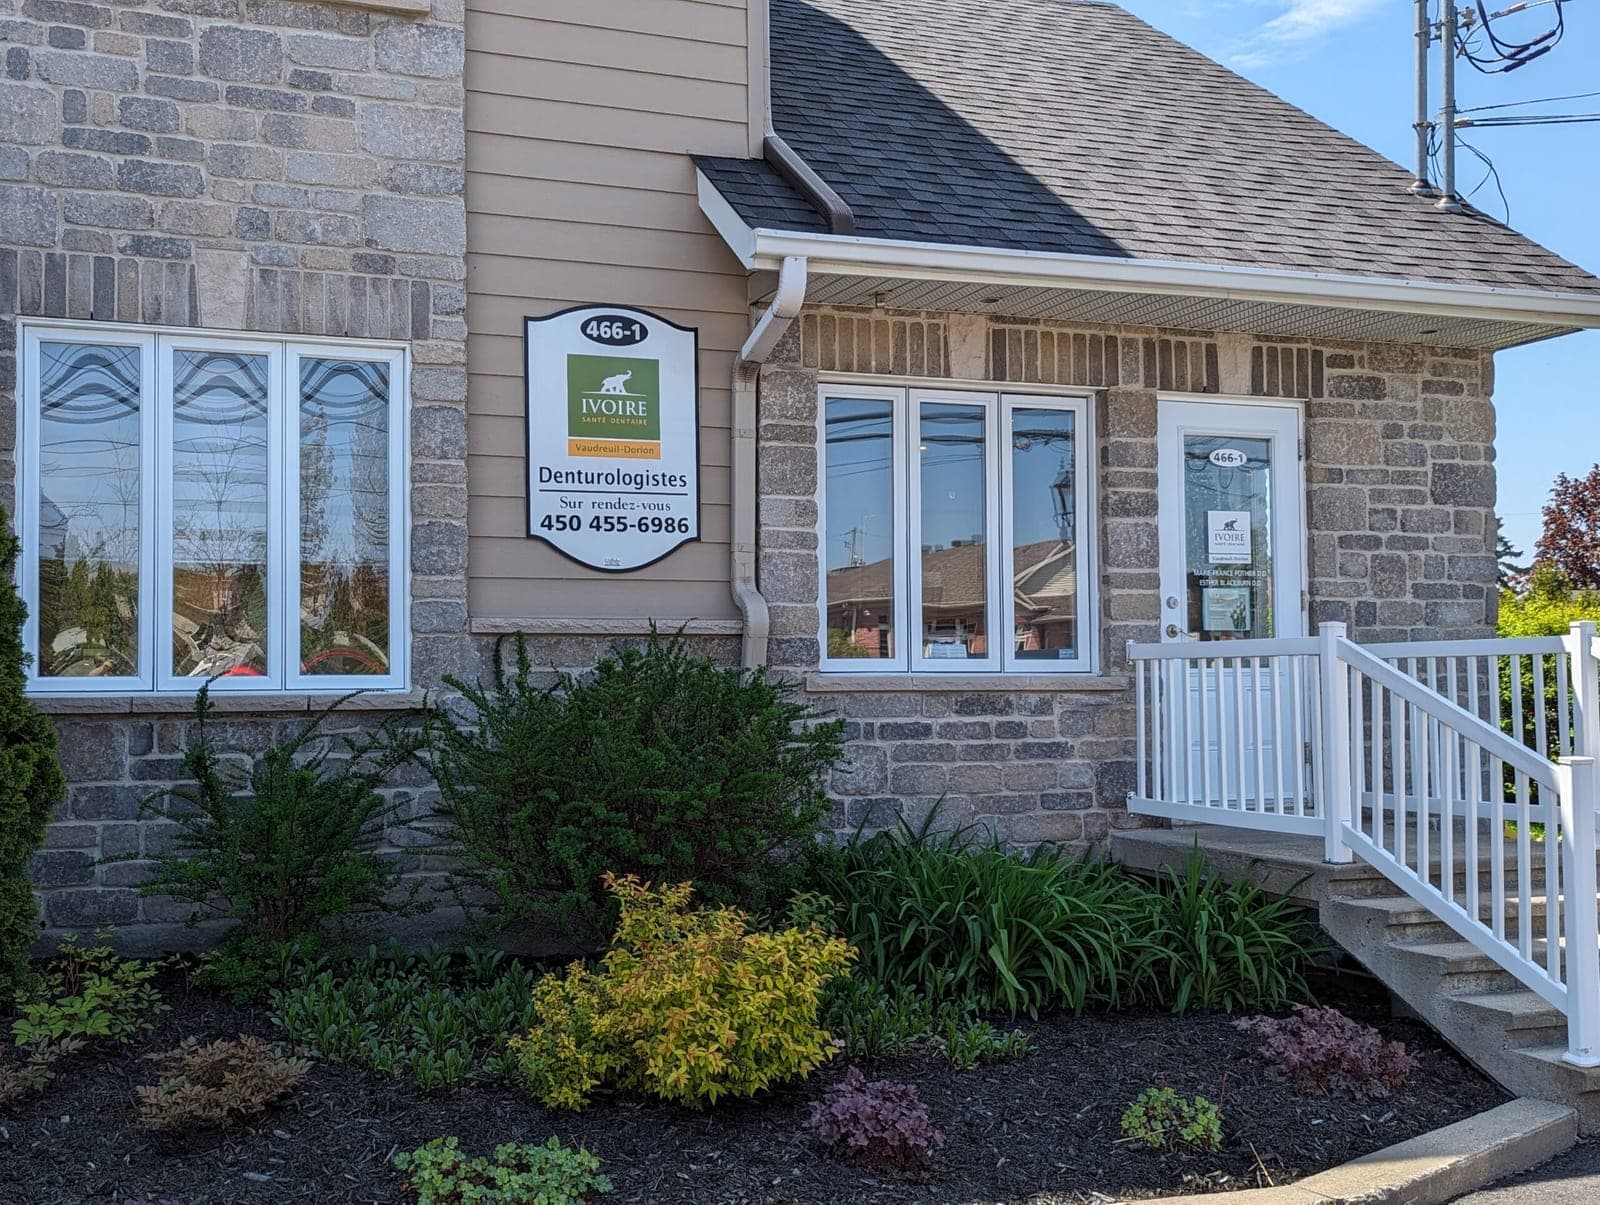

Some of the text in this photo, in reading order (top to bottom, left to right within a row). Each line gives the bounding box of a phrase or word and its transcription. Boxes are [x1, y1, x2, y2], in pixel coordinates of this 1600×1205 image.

[585, 320, 641, 341] 466-1
[581, 398, 648, 416] IVOIRE
[581, 416, 648, 426] SANTÉ DENTAIRE
[575, 443, 655, 455] Vaudreuil-Dorion
[1213, 452, 1243, 463] 466-1
[539, 466, 687, 490] Denturologistes
[559, 496, 671, 512] Sur rendez-vous
[540, 514, 689, 534] 450 455-6986
[1214, 532, 1245, 543] IVOIRE
